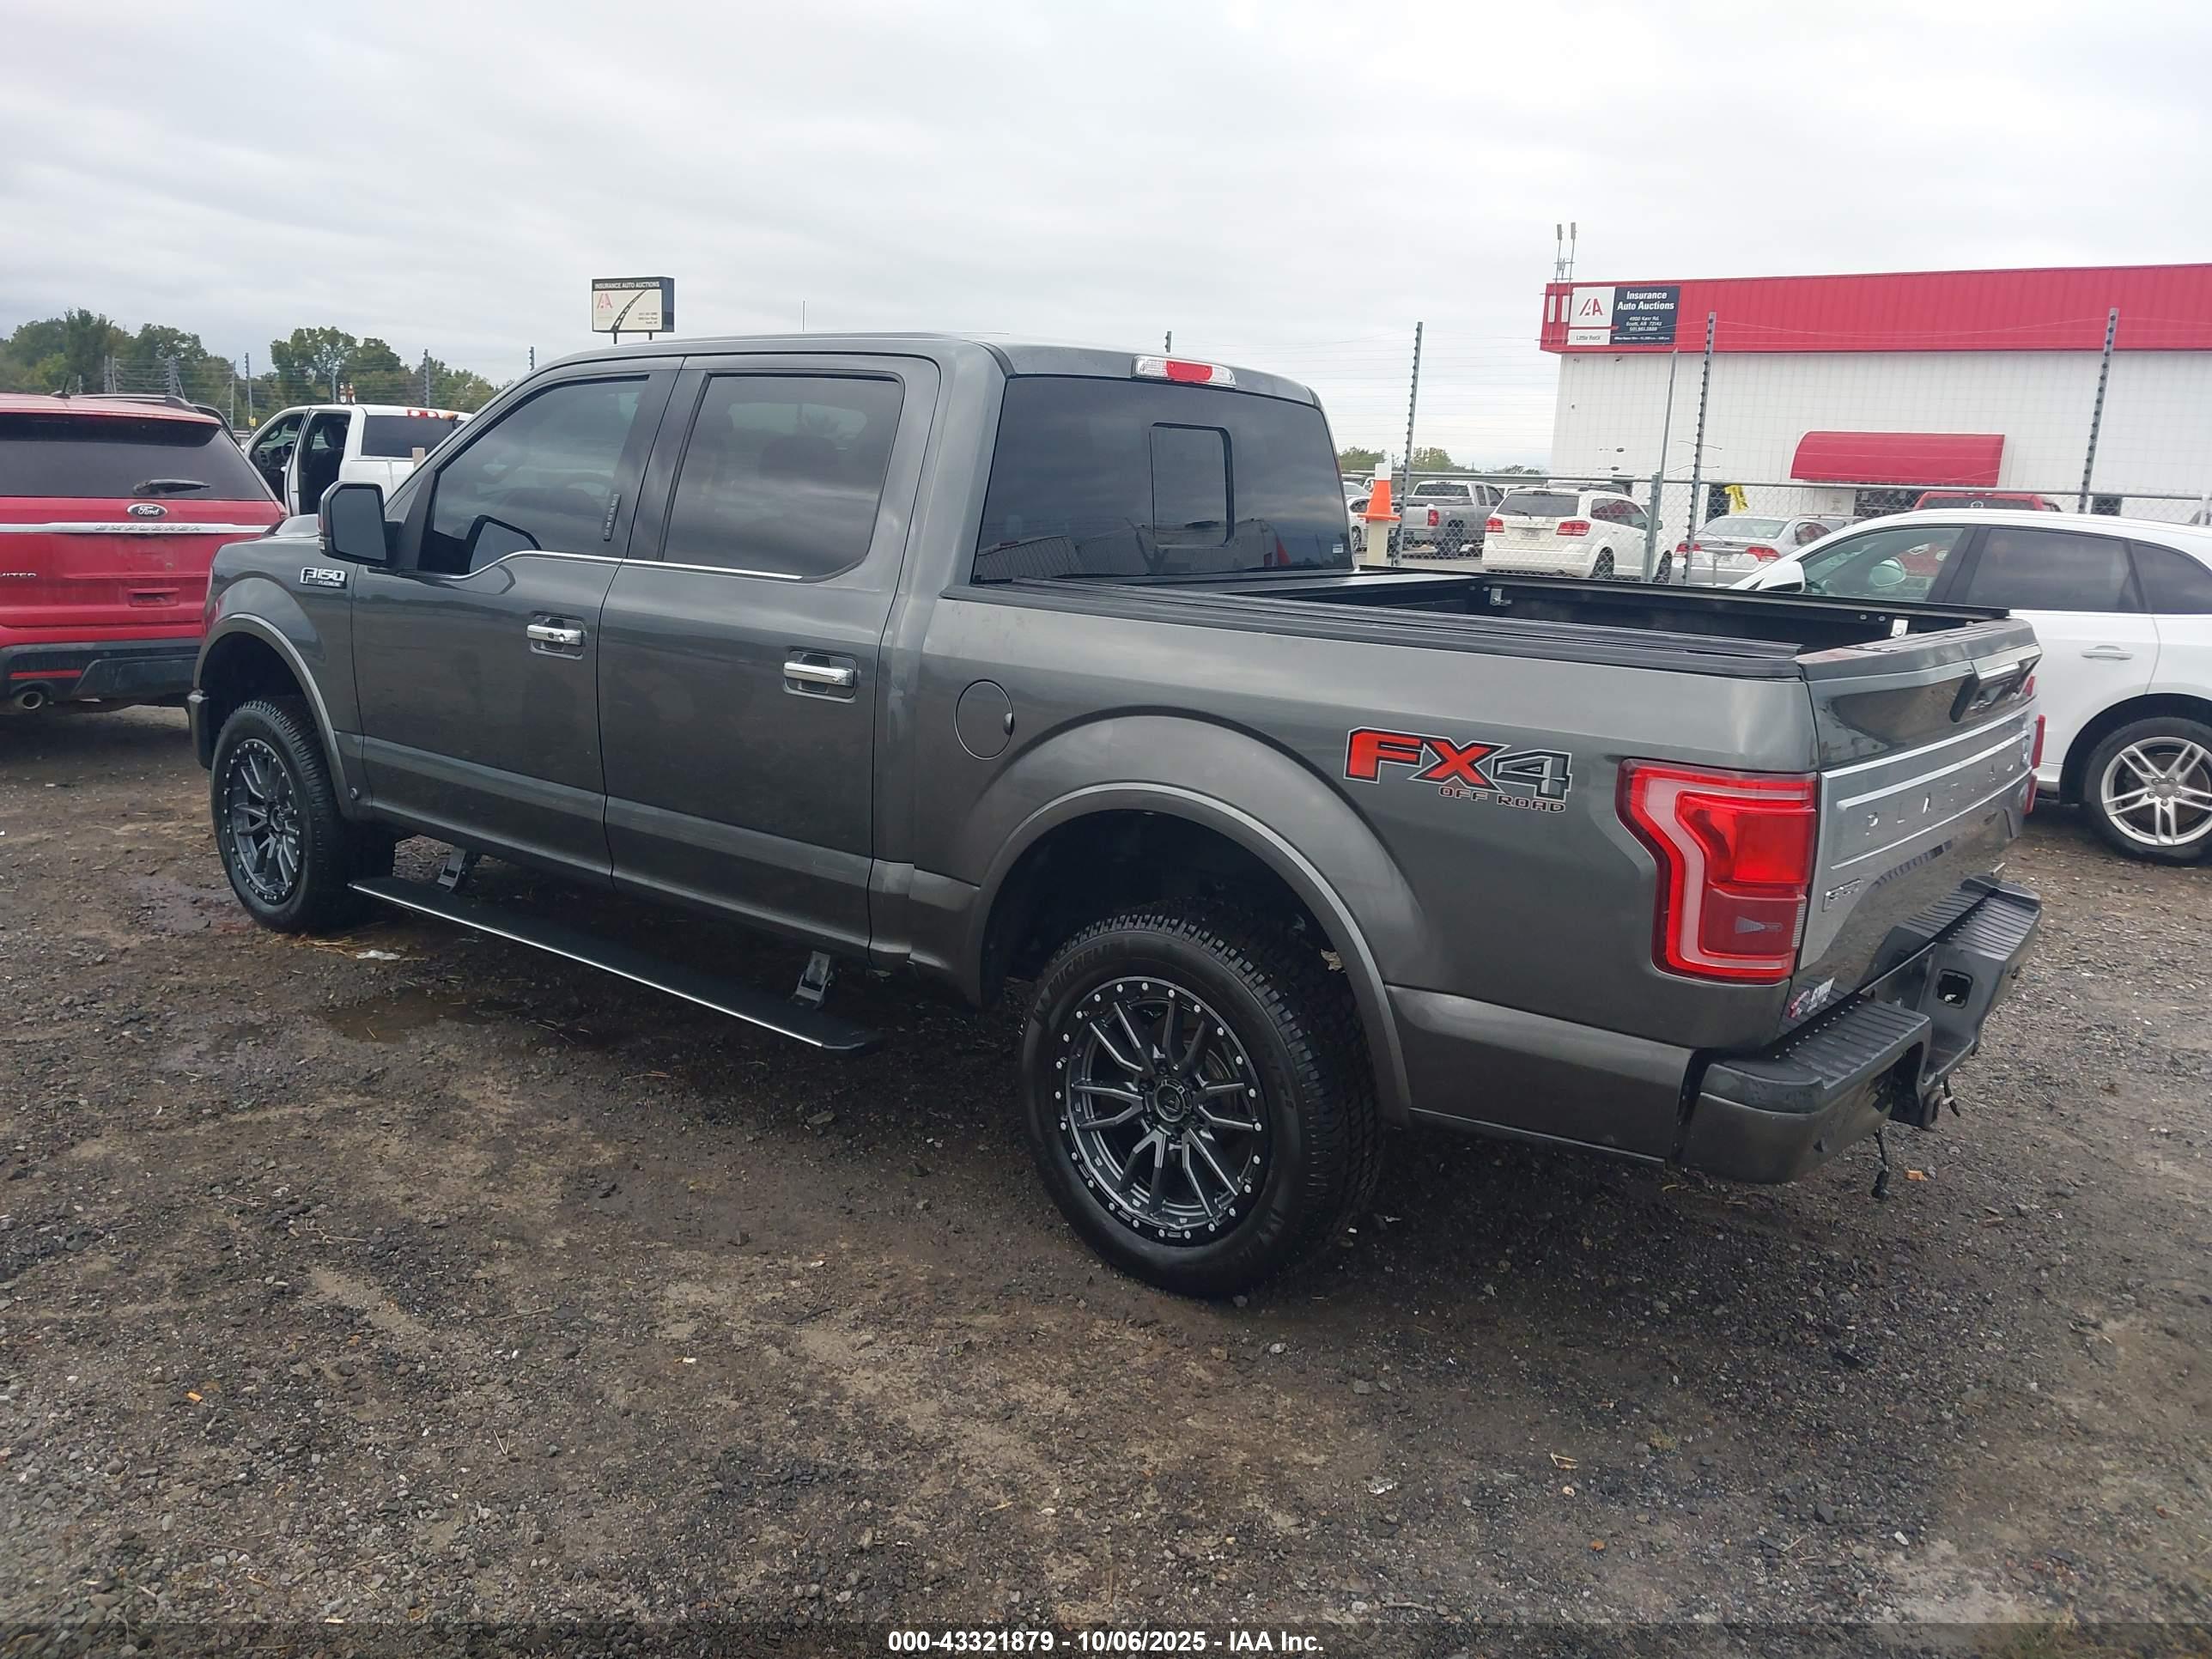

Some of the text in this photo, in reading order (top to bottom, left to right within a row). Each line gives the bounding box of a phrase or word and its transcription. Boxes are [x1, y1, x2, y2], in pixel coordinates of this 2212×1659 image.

[1626, 290, 1668, 301] Insurance
[1616, 301, 1675, 311] Auto Auctions
[95, 524, 203, 532] EXPLORER
[1344, 726, 1573, 802] FX4
[1438, 785, 1567, 814] OFF ROAD
